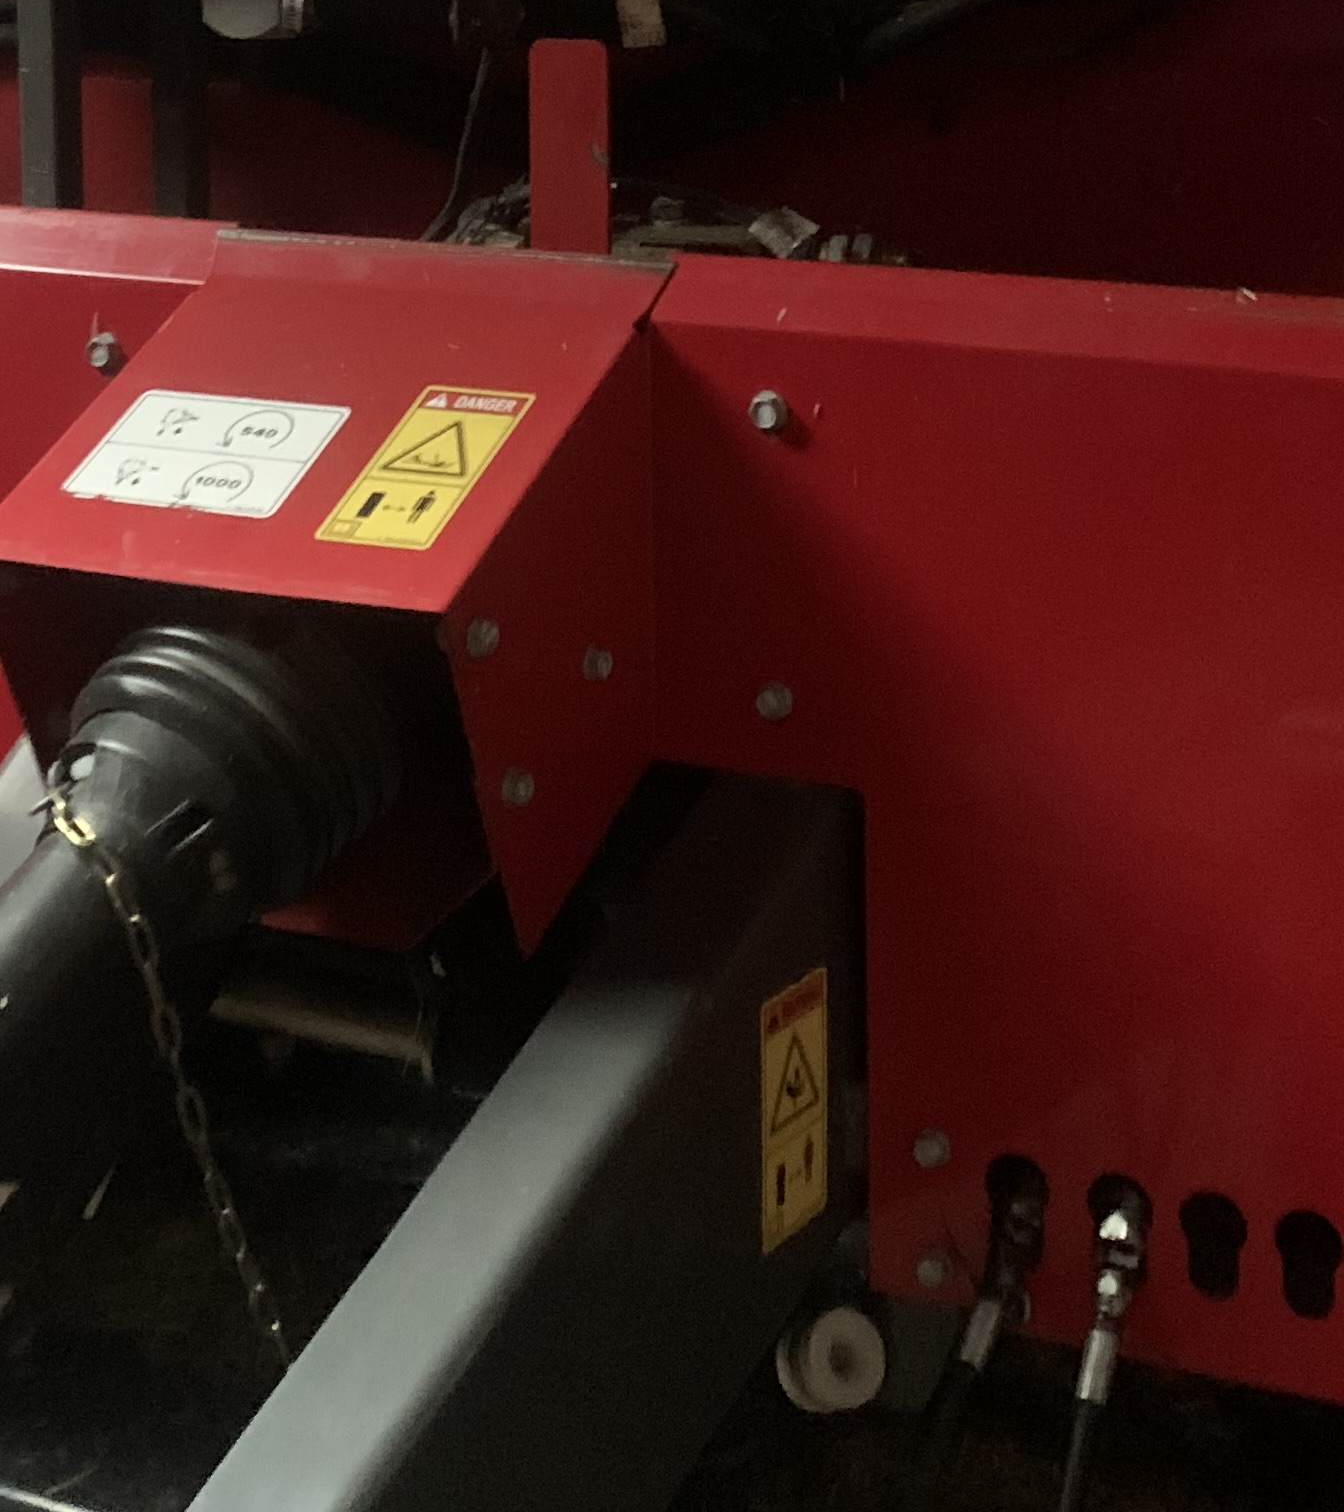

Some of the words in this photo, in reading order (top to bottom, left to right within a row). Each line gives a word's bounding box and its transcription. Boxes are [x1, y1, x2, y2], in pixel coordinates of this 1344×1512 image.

[453, 394, 518, 414] DANGER
[240, 426, 279, 439] 540
[196, 475, 242, 489] 1000
